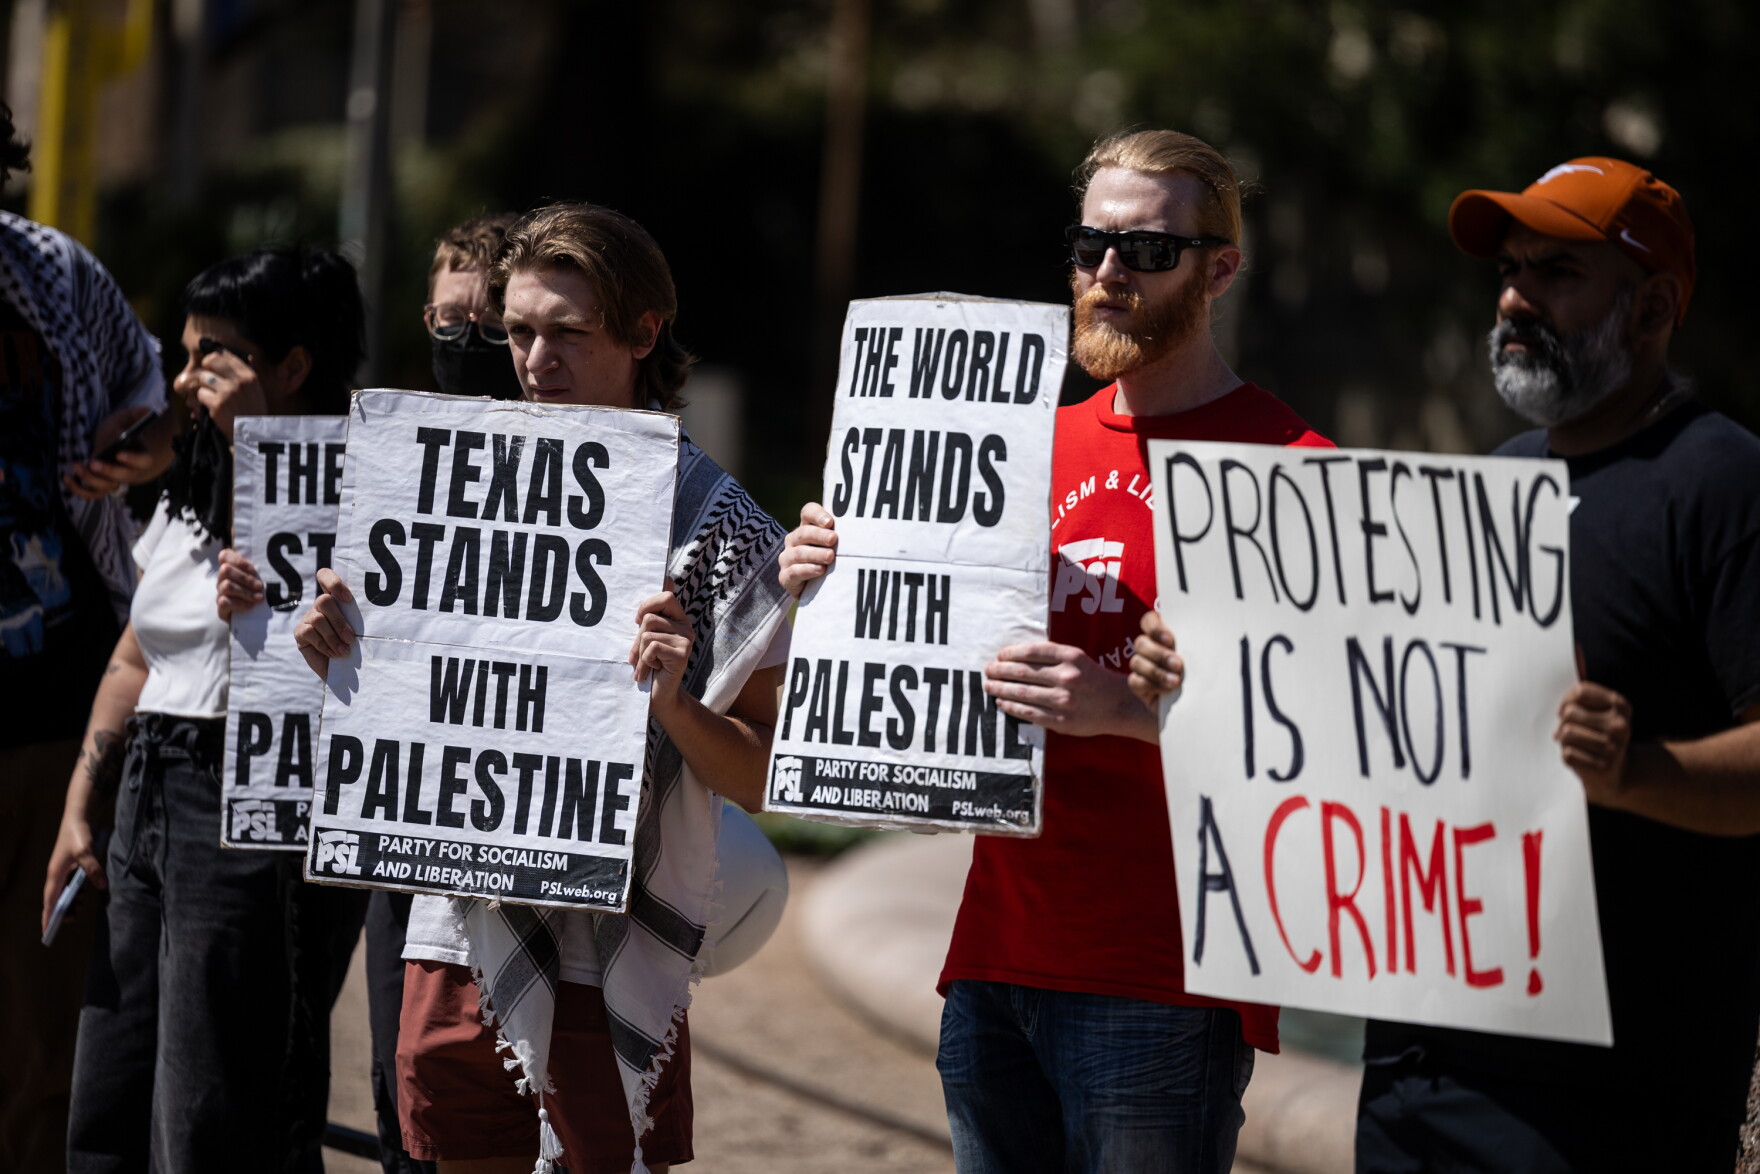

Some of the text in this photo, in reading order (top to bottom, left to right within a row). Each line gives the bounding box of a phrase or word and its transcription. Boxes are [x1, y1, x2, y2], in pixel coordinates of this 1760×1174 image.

[849, 326, 1046, 405] THE WORLD
[258, 442, 346, 505] THE
[416, 426, 610, 530] TEXAS
[832, 427, 1007, 527] STANDS
[1104, 469, 1119, 490] &
[1166, 452, 1564, 628] PROTESTING
[364, 518, 613, 627] STANDS
[1050, 560, 1124, 615] PSL
[854, 568, 950, 645] WITH
[429, 655, 548, 733] WITH
[1240, 634, 1487, 785] IS NOT
[323, 734, 634, 846] PALESTINE
[772, 769, 804, 802] PSL
[810, 785, 929, 813] AND LIBERATION
[815, 759, 977, 790] PARTY FOR SOCIALISM
[231, 811, 283, 842] PSL
[952, 800, 1029, 823] PSLweb.org
[315, 842, 362, 875] PSL
[372, 860, 514, 891] AND LIBERATION
[378, 835, 568, 871] PARTY FOR SOCIALISM
[540, 880, 617, 904] PSLweb.org
[1193, 793, 1261, 976] A
